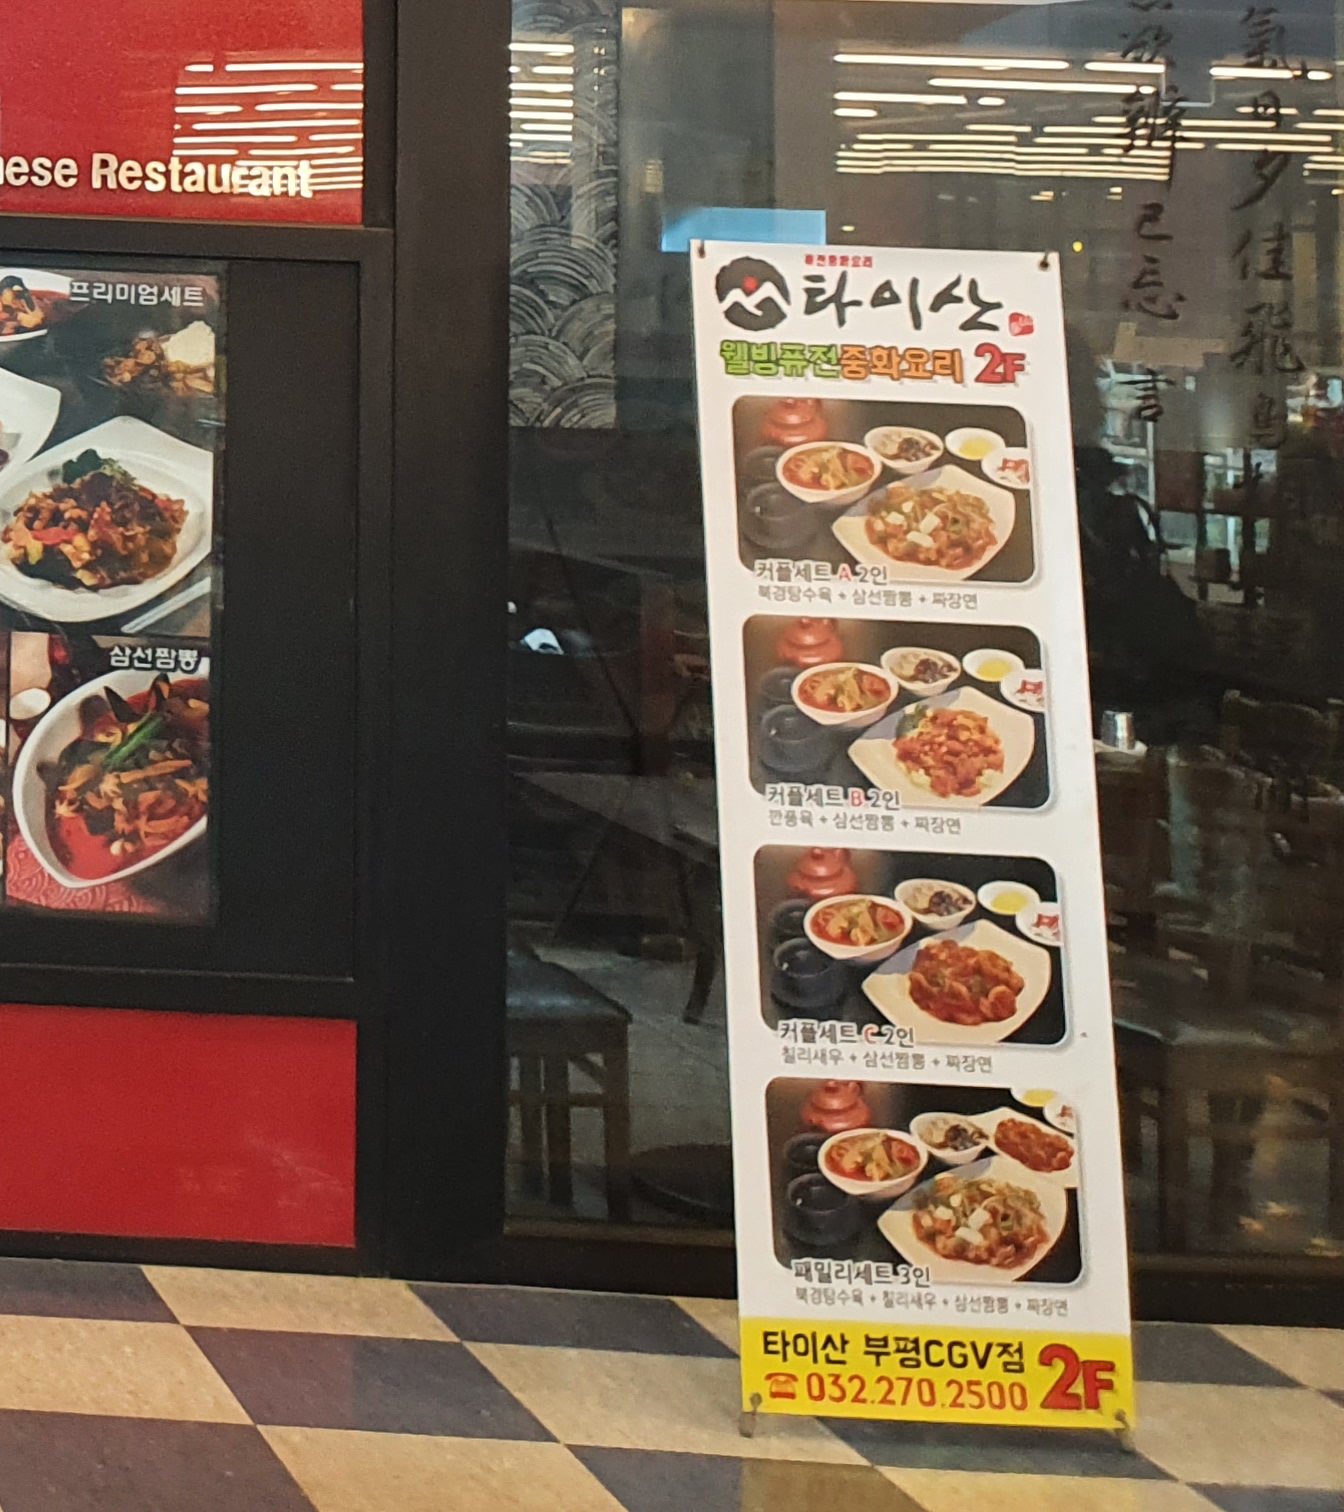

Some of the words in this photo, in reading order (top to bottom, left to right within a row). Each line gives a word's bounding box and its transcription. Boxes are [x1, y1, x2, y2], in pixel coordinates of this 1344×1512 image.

[90, 149, 314, 199] Restaurant
[69, 281, 205, 307] 프리미엄세트
[802, 269, 1004, 332] 타이산
[719, 338, 966, 384] 웰빙퓨전중화요리
[973, 341, 1027, 384] 2F
[755, 559, 831, 583] 커플세트
[838, 563, 853, 582] A
[858, 564, 888, 586] 2인
[756, 584, 833, 604] 북경탕수육
[931, 591, 978, 610] 짜장면
[109, 645, 199, 672] 삼선짬뽕
[767, 784, 843, 808] 커플세트
[849, 789, 863, 807] B
[869, 790, 900, 811] 2인
[914, 816, 962, 835] 짜장면
[779, 1022, 857, 1045] 커플세트
[863, 1026, 878, 1045] C
[882, 1027, 914, 1049] 2인
[782, 1046, 844, 1066] 칠리새우
[945, 1054, 993, 1074] 짜장면
[794, 1260, 895, 1286] 패밀리세트
[897, 1266, 931, 1289] 3인
[762, 1329, 850, 1365] 타이산
[863, 1334, 1025, 1374] 부평CGV점
[1037, 1342, 1117, 1411] 2F
[806, 1372, 1029, 1412] 032.270.2500
